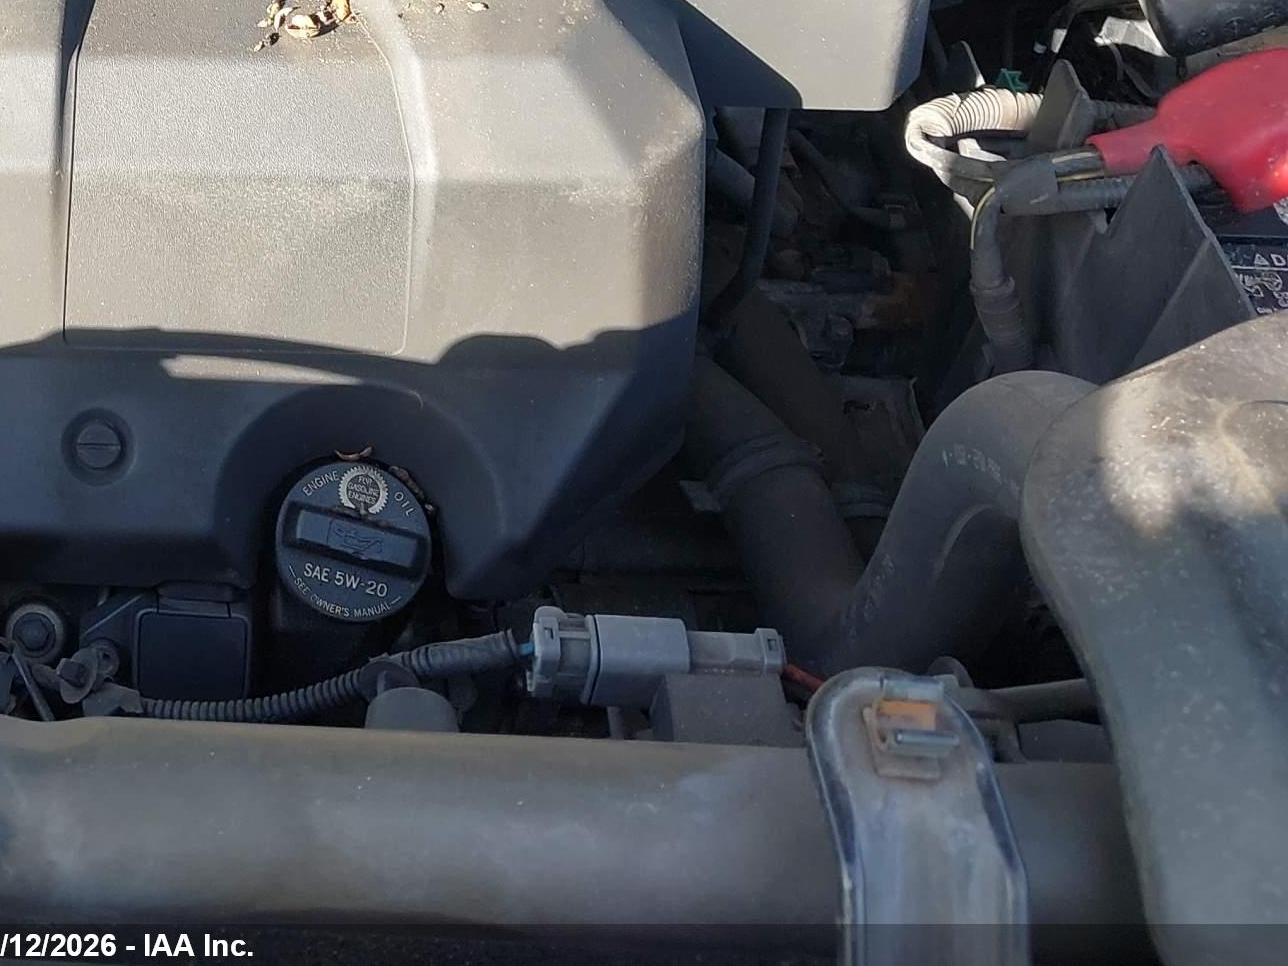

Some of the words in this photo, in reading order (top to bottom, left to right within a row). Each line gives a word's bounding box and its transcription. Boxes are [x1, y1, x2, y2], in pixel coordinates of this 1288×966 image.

[302, 470, 340, 497] ENGINE
[394, 491, 417, 517] OIL
[346, 482, 380, 498] GASOLINE
[358, 476, 373, 486] FOR
[346, 490, 378, 505] ENGINES
[303, 562, 331, 583] SAE
[334, 570, 389, 598] 5W-20
[293, 577, 312, 595] SEE
[310, 594, 351, 618] OWNER'S
[353, 602, 392, 618] MANUAL
